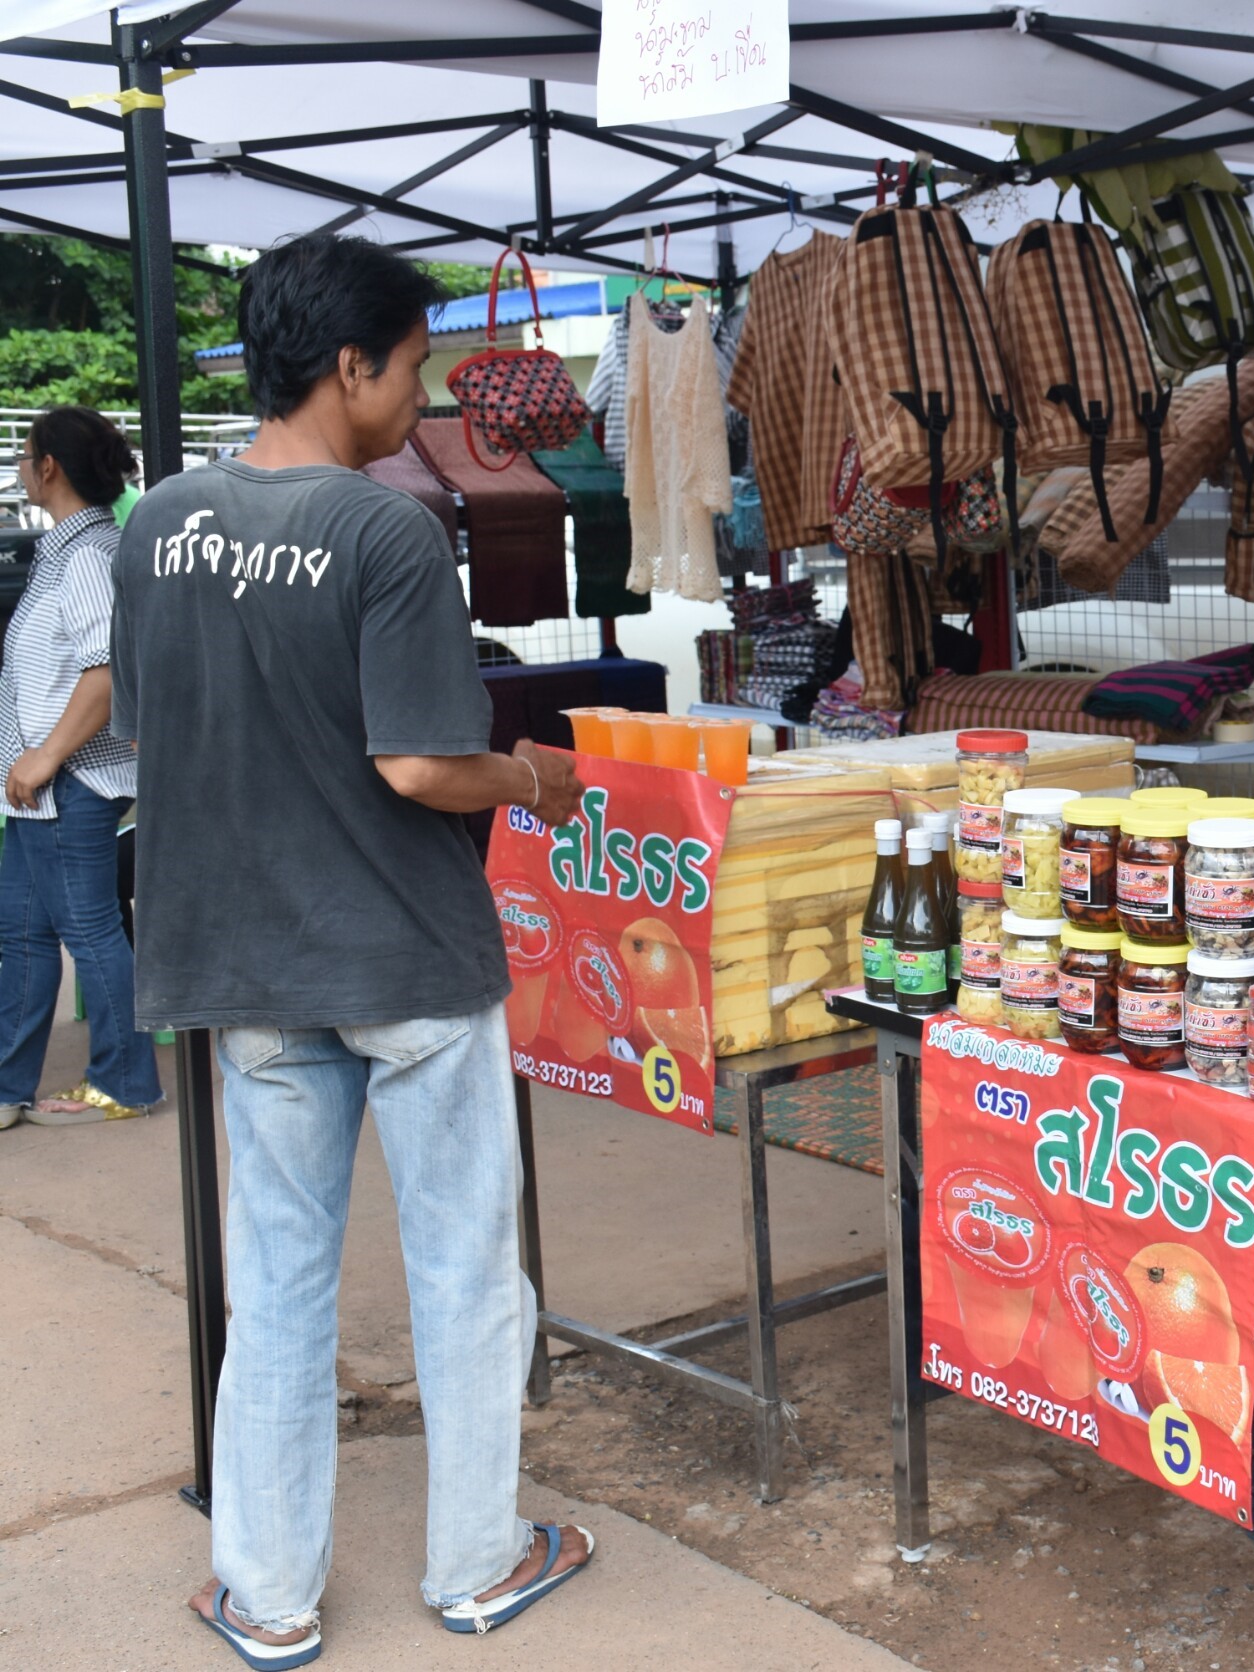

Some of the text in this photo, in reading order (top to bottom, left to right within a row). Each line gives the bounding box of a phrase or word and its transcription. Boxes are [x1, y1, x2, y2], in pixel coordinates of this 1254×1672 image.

[549, 787, 711, 914] สโรธร
[513, 1050, 613, 1096] 082-3737123
[654, 1056, 704, 1117] 5 บาท
[975, 1080, 1030, 1125] ตรา
[928, 1343, 962, 1388] โทร
[1163, 1415, 1236, 1501] 5 บาท
